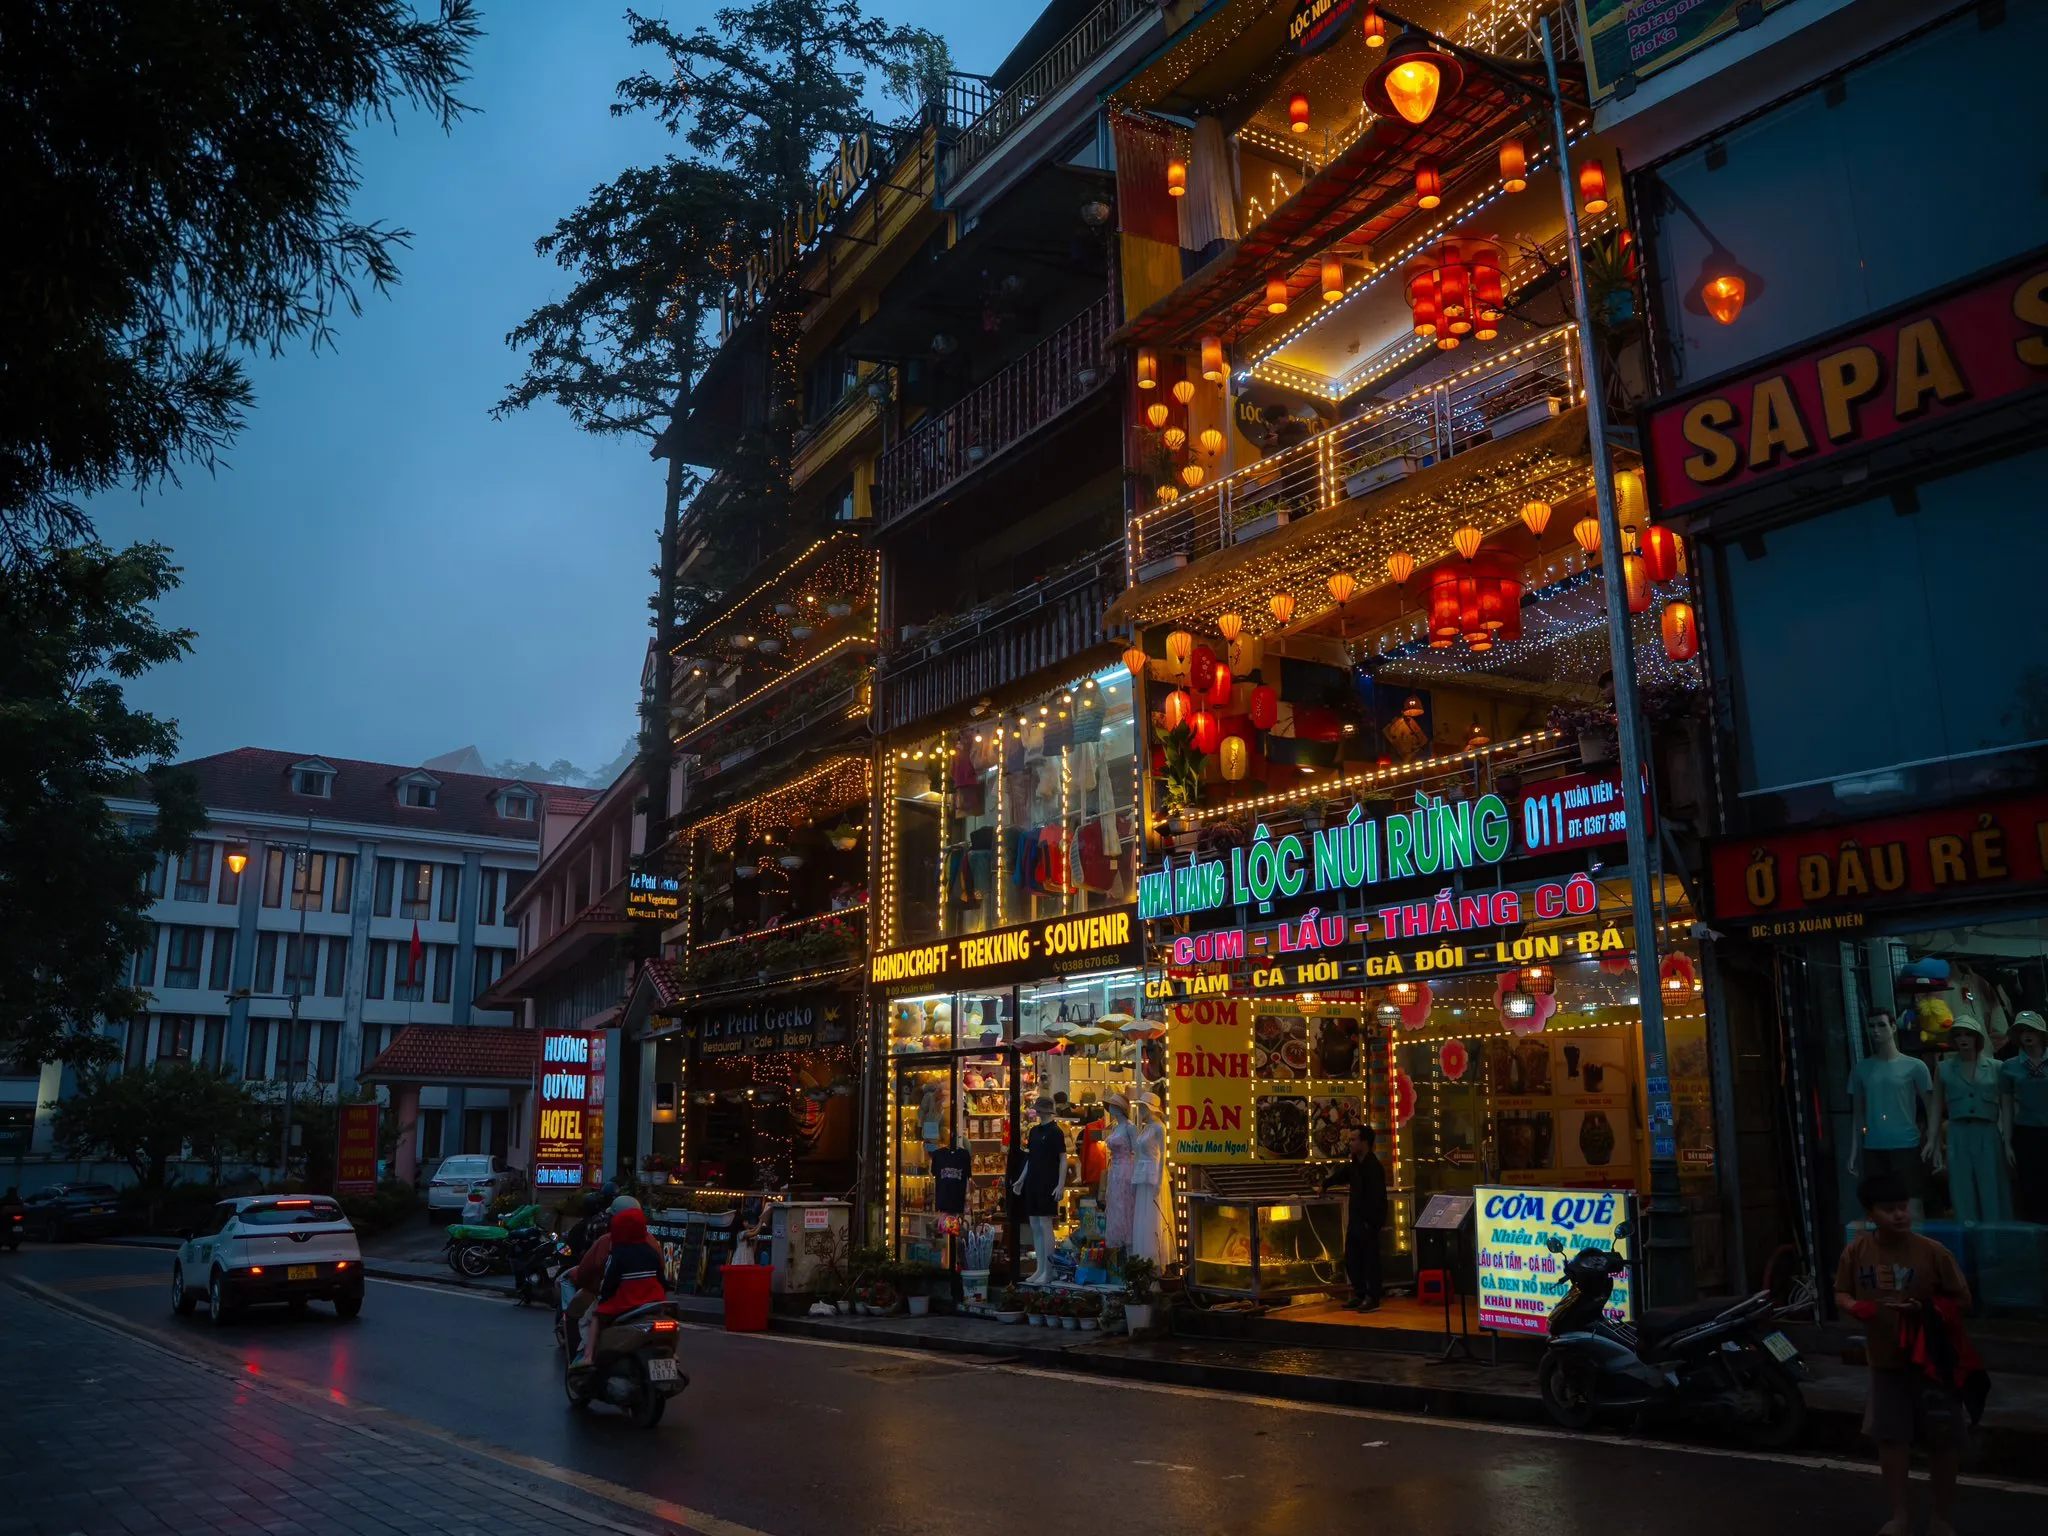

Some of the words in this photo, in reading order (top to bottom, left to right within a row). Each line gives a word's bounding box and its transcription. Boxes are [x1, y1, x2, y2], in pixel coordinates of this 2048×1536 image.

[796, 131, 869, 245] Gecko
[1682, 317, 1972, 484] SAPA
[1564, 784, 1590, 809] XUÂN
[1590, 780, 1614, 804] VIÊN
[1524, 792, 1563, 849] 011
[1584, 814, 1606, 835] 0367
[1608, 810, 1627, 831] 389
[1175, 851, 1225, 915] HÀNG
[1232, 824, 1304, 914] LỘC
[1314, 803, 1378, 892] NÚI
[1387, 789, 1510, 880] RỪNG
[1799, 837, 1906, 901] ĐÂU
[1928, 812, 2008, 884] RẺ
[629, 872, 640, 889] Le
[641, 873, 657, 890] Petit
[658, 908, 678, 920] Food
[1174, 930, 1244, 965] CƠM
[1278, 907, 1344, 953] LẨU
[1379, 887, 1519, 940] THẮNG
[1774, 921, 1795, 935] 013
[872, 944, 949, 983] HANDICRAFT
[959, 929, 1030, 969] TREKKING
[1044, 912, 1130, 957] SOUVENIR
[1062, 960, 1084, 972] 0388
[1084, 956, 1101, 968] 670
[1102, 953, 1120, 966] 663
[704, 1018, 720, 1037] Le
[727, 1012, 759, 1034] Petit
[764, 1005, 812, 1030] Gecko
[544, 1035, 588, 1063] HƯƠNG
[703, 1040, 742, 1053] Restaurant
[783, 1032, 813, 1046] Bakery
[1175, 1045, 1249, 1078] BÌNH
[543, 1069, 586, 1101] QUỲNH
[540, 1109, 583, 1140] HOTEL
[1175, 1098, 1242, 1132] DÂN
[1485, 1193, 1545, 1222] CƠM
[1550, 1193, 1617, 1230] QUÊ
[1491, 1228, 1532, 1246] Nhiều
[1570, 1234, 1611, 1251] Ngon
[1493, 1252, 1503, 1269] CÁ
[1529, 1255, 1540, 1272] CÁ
[1481, 1273, 1496, 1289] GÀ
[1498, 1277, 1520, 1293] ĐEN
